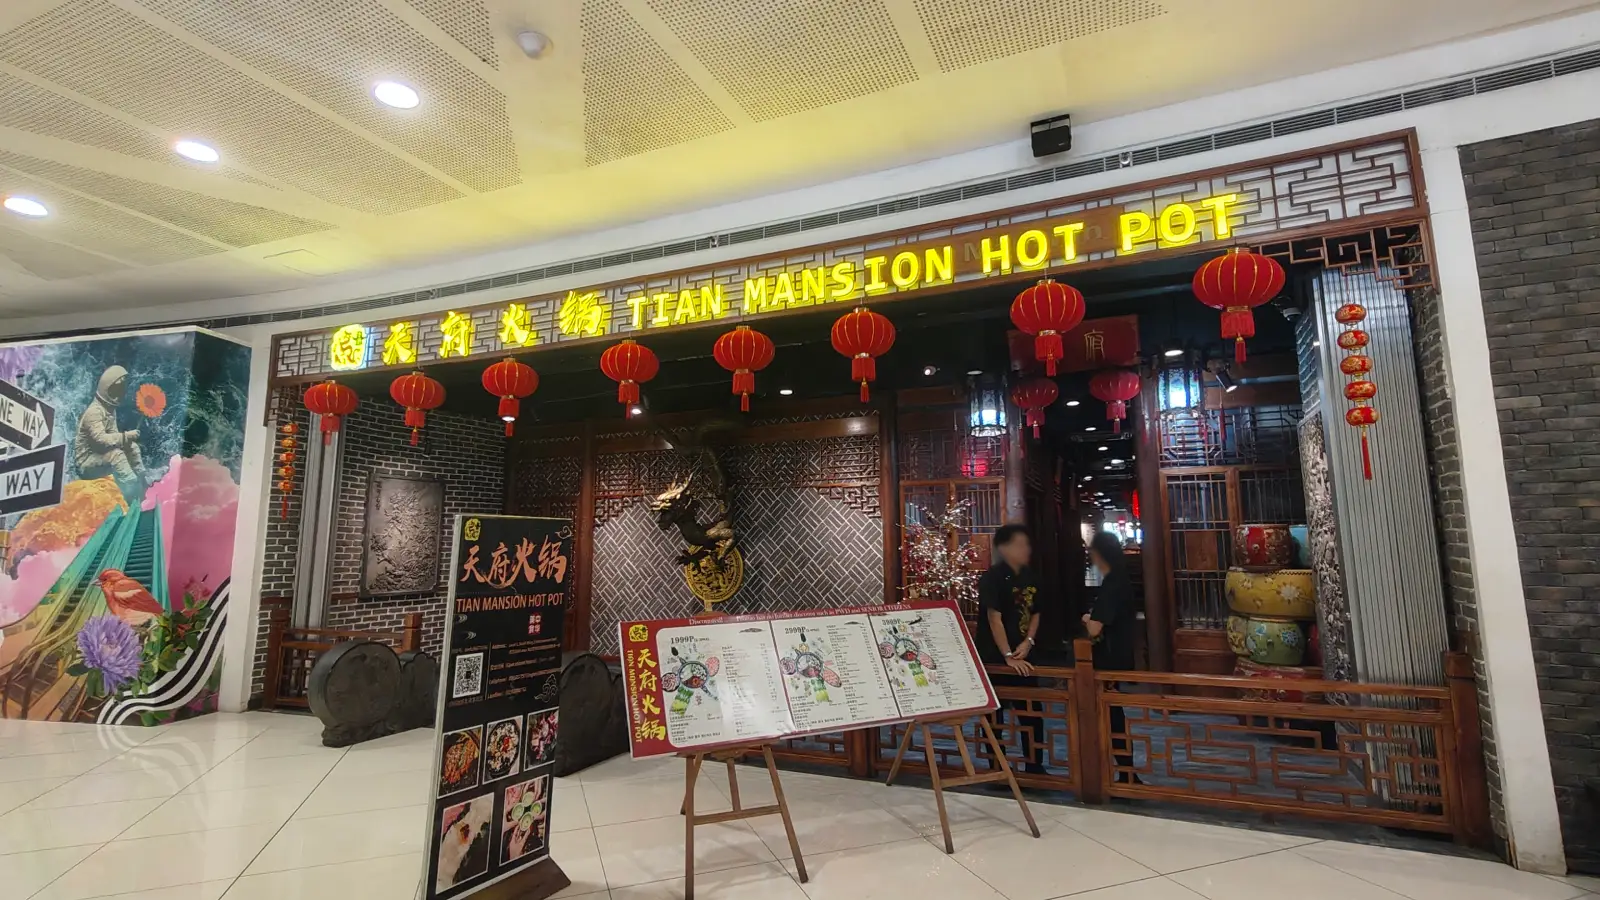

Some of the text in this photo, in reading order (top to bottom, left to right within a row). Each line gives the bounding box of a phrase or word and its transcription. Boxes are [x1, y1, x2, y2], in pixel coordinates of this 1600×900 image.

[627, 284, 723, 328] TIAN
[744, 246, 953, 312] MANSION
[982, 222, 1085, 275] HOT
[1119, 194, 1237, 252] POT
[0, 398, 44, 438] NE WAY
[6, 467, 46, 497] WAY
[460, 535, 567, 588] 天府火锅
[456, 592, 565, 613] TIAN MANSION HOT POT
[670, 636, 695, 645] 1999P
[637, 648, 666, 741] 天府火锅
